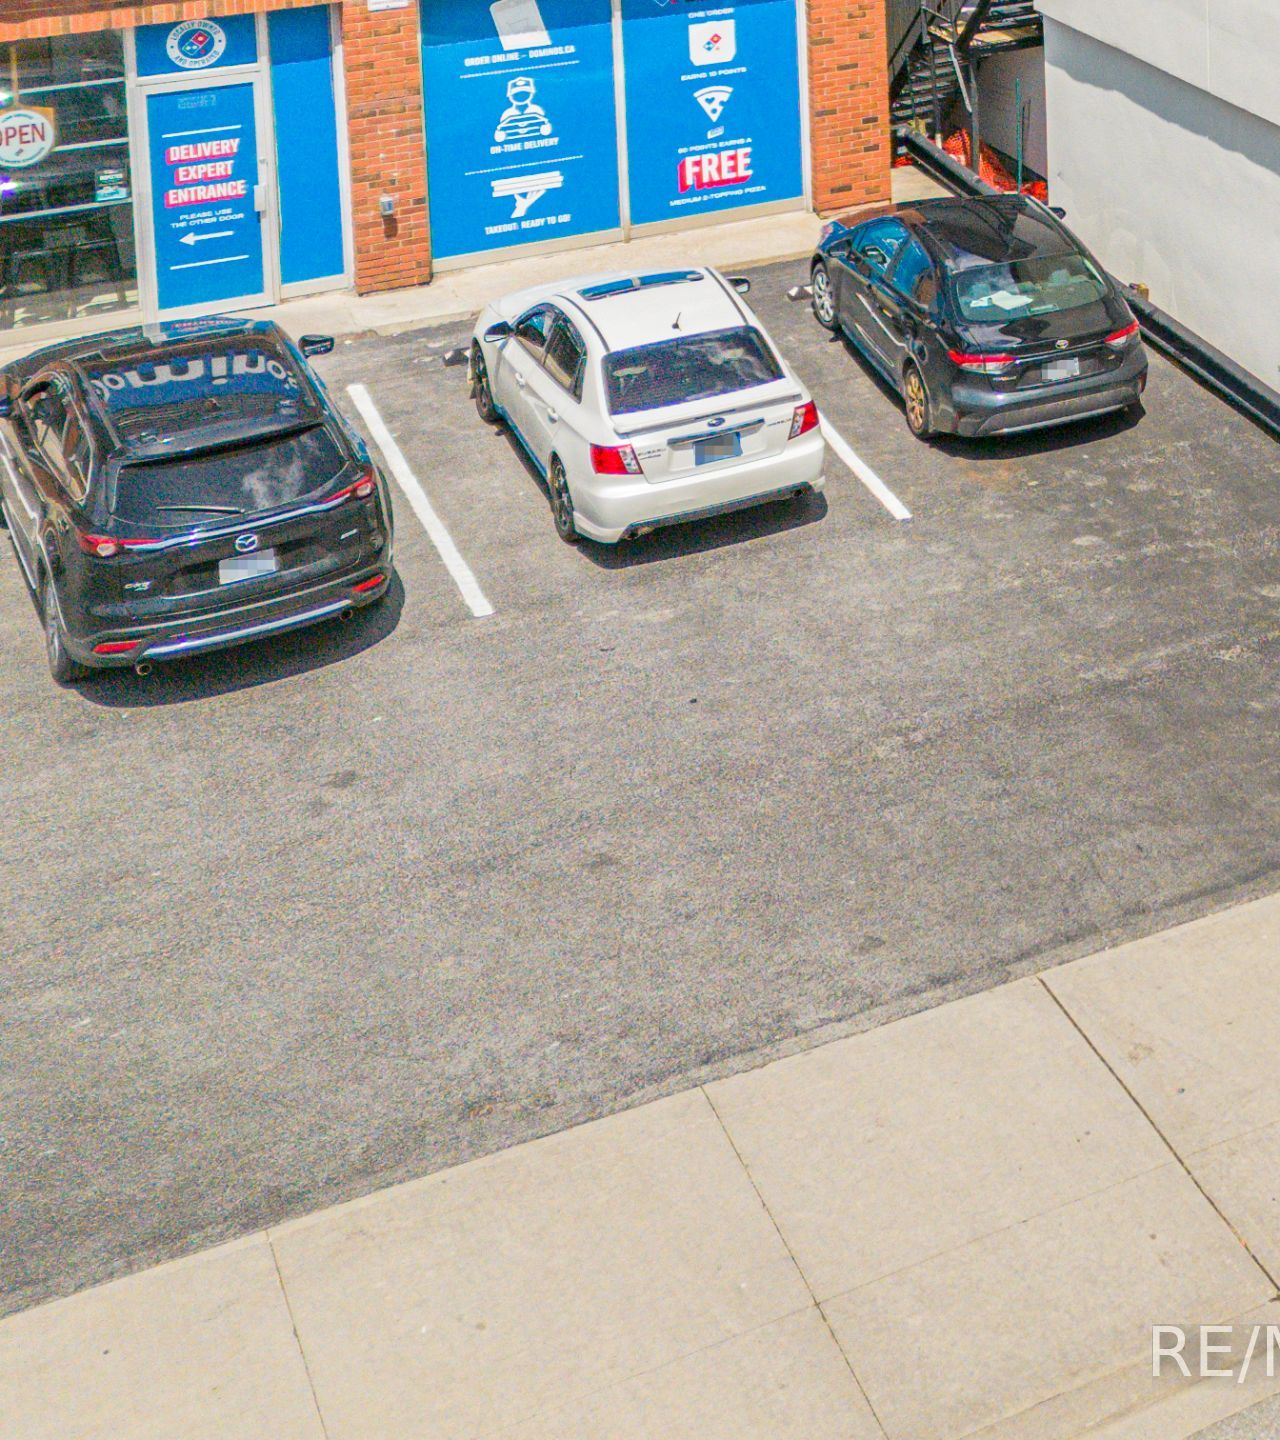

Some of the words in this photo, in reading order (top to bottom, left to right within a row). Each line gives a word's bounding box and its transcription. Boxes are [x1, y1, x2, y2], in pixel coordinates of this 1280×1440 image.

[464, 55, 491, 67] ORDER
[492, 52, 520, 63] ONLINE
[718, 67, 748, 77] POINTS
[0, 123, 46, 147] PEN
[168, 138, 240, 162] DELIVERY
[489, 142, 522, 155] ON-TIME
[523, 136, 559, 150] DELIVERY
[689, 142, 718, 152] POINTS
[718, 138, 746, 148] EARNS
[177, 160, 235, 182] EXPERT
[684, 147, 754, 186] FREE
[167, 179, 247, 205] ENTRANCE
[669, 195, 702, 207] MEDIUM
[744, 185, 767, 194] PIZZA
[170, 221, 188, 229] THE
[188, 216, 217, 227] OTHER
[218, 212, 245, 222] DOOR
[179, 210, 213, 221] PLEASE
[214, 207, 233, 215] USE
[520, 218, 546, 229] READY
[546, 215, 557, 225] TO
